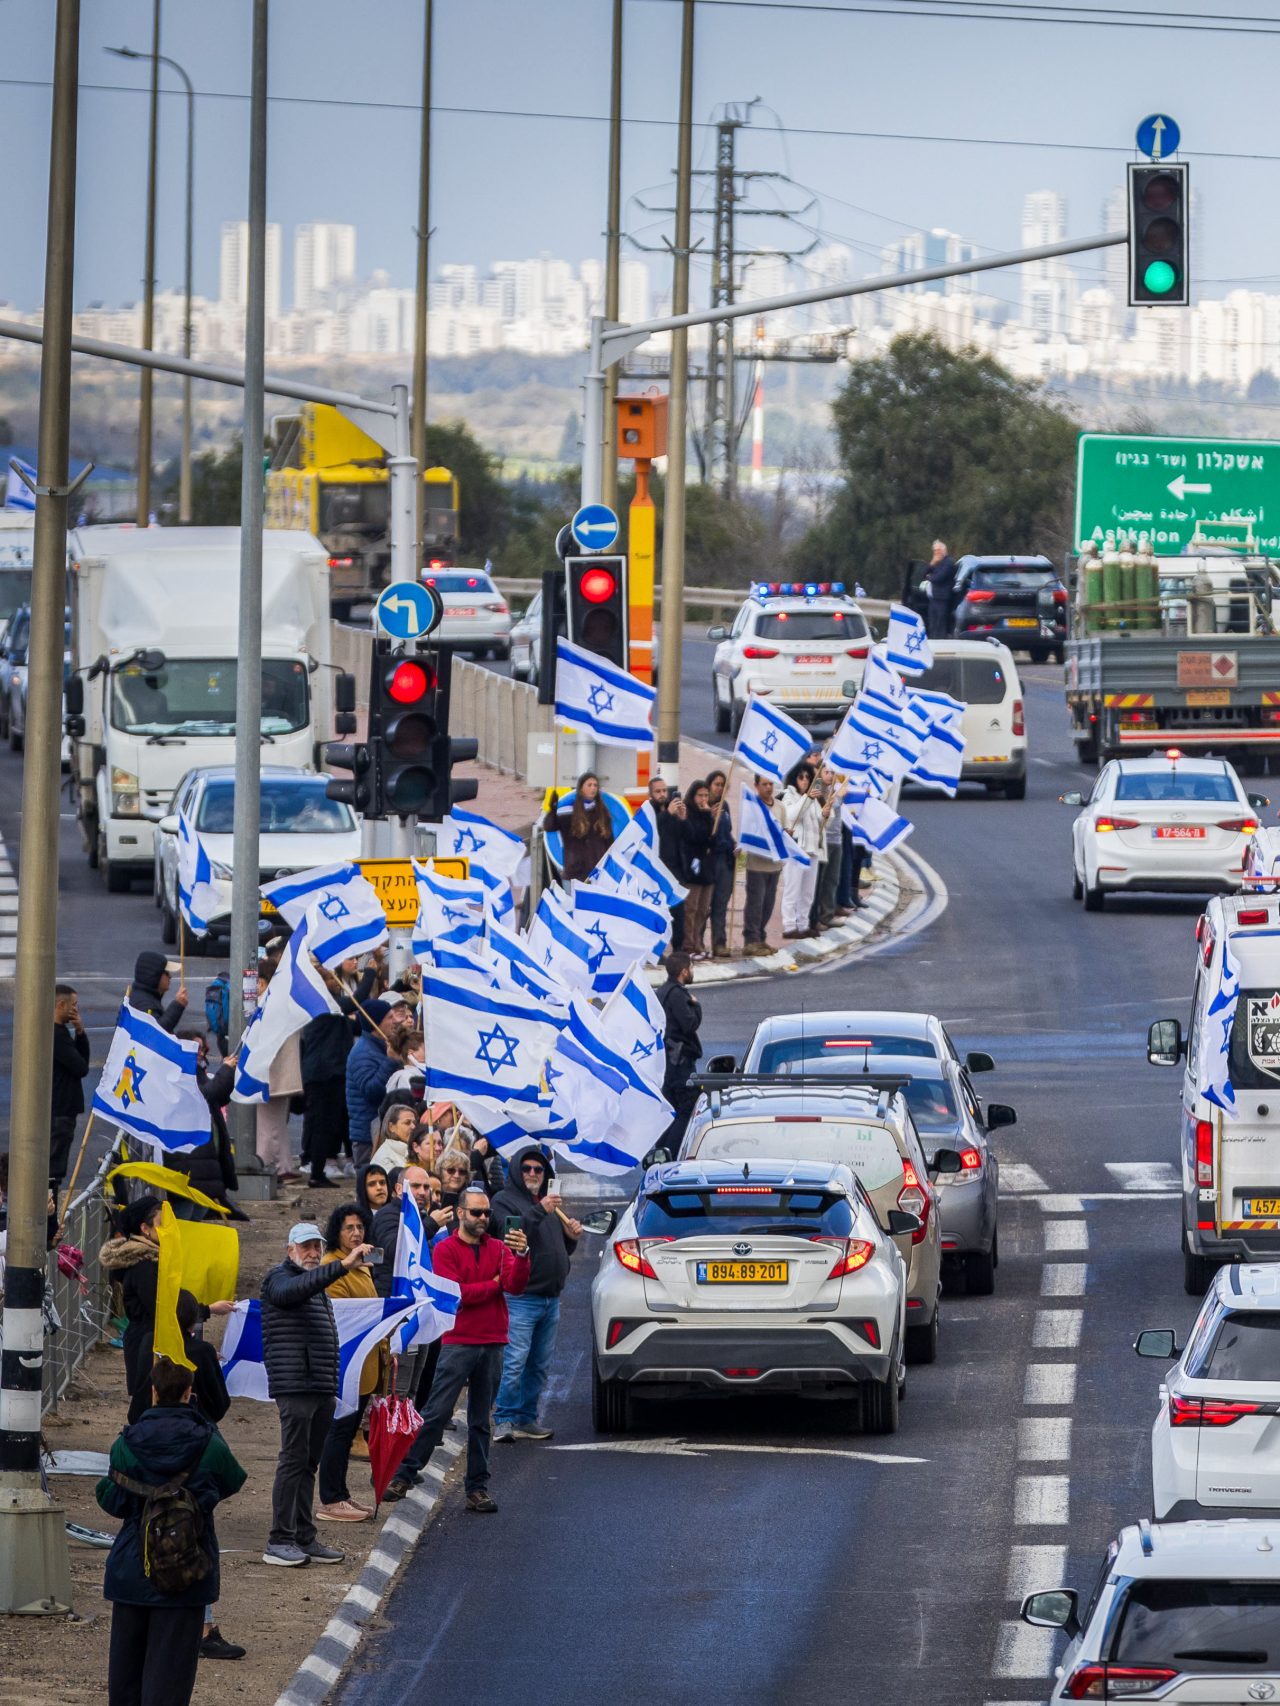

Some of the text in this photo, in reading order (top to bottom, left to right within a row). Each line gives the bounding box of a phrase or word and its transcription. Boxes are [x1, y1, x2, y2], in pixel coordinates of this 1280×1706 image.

[1197, 451, 1265, 470] אשקלון
[1091, 525, 1181, 543] Ashkelon
[363, 875, 417, 890] התקד
[380, 898, 419, 911] העצי
